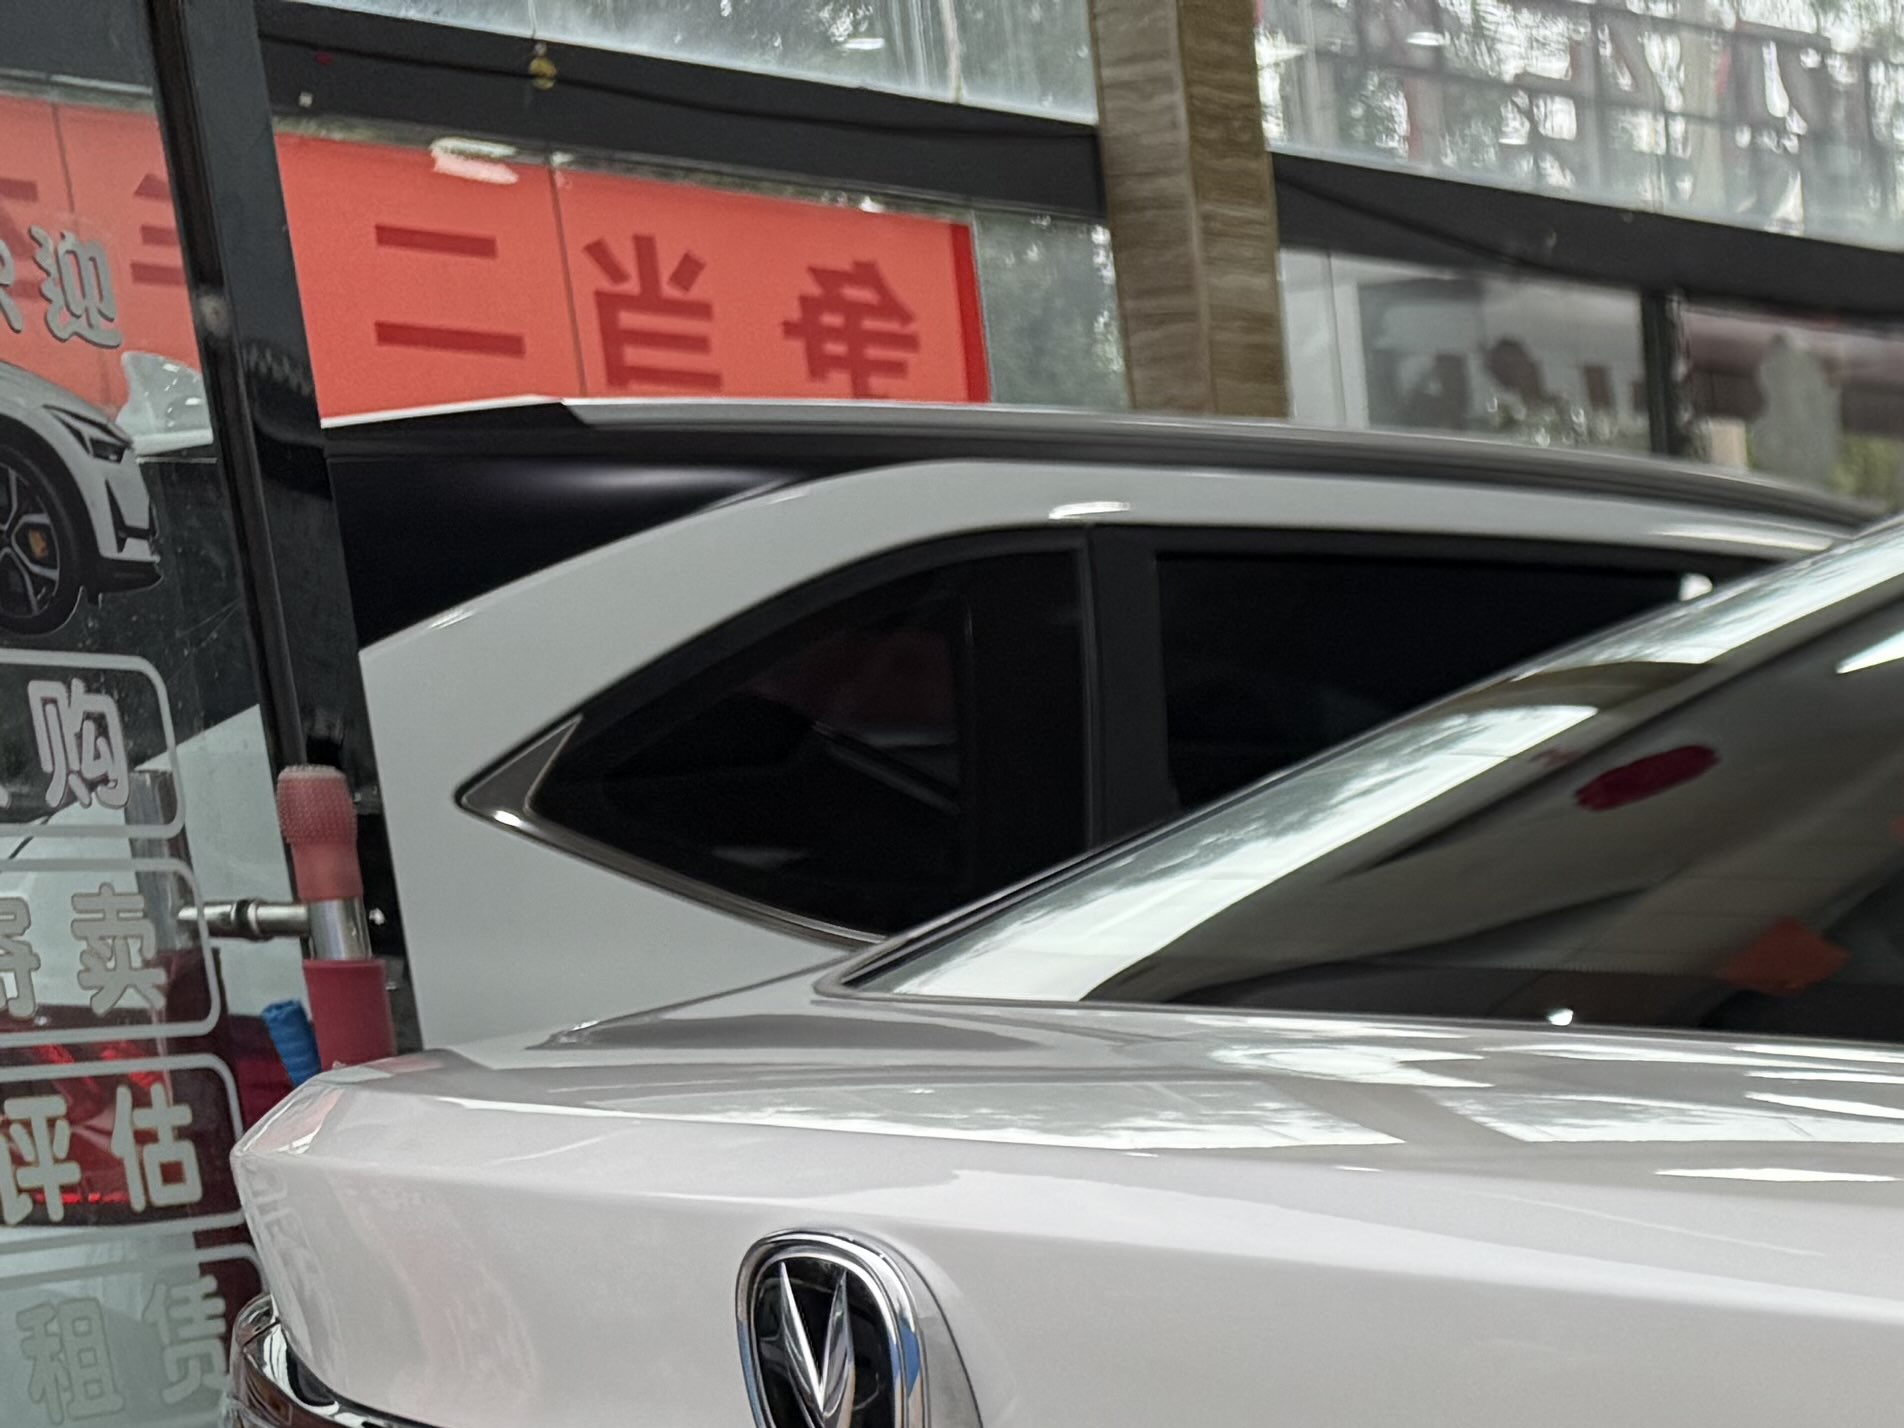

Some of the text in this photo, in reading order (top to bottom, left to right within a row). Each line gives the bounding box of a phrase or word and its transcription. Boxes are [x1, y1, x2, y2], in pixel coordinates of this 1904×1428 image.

[0, 224, 122, 349] 迎
[28, 677, 131, 811] 购
[0, 1082, 203, 1226] 评估
[15, 1274, 231, 1426] 租赁
